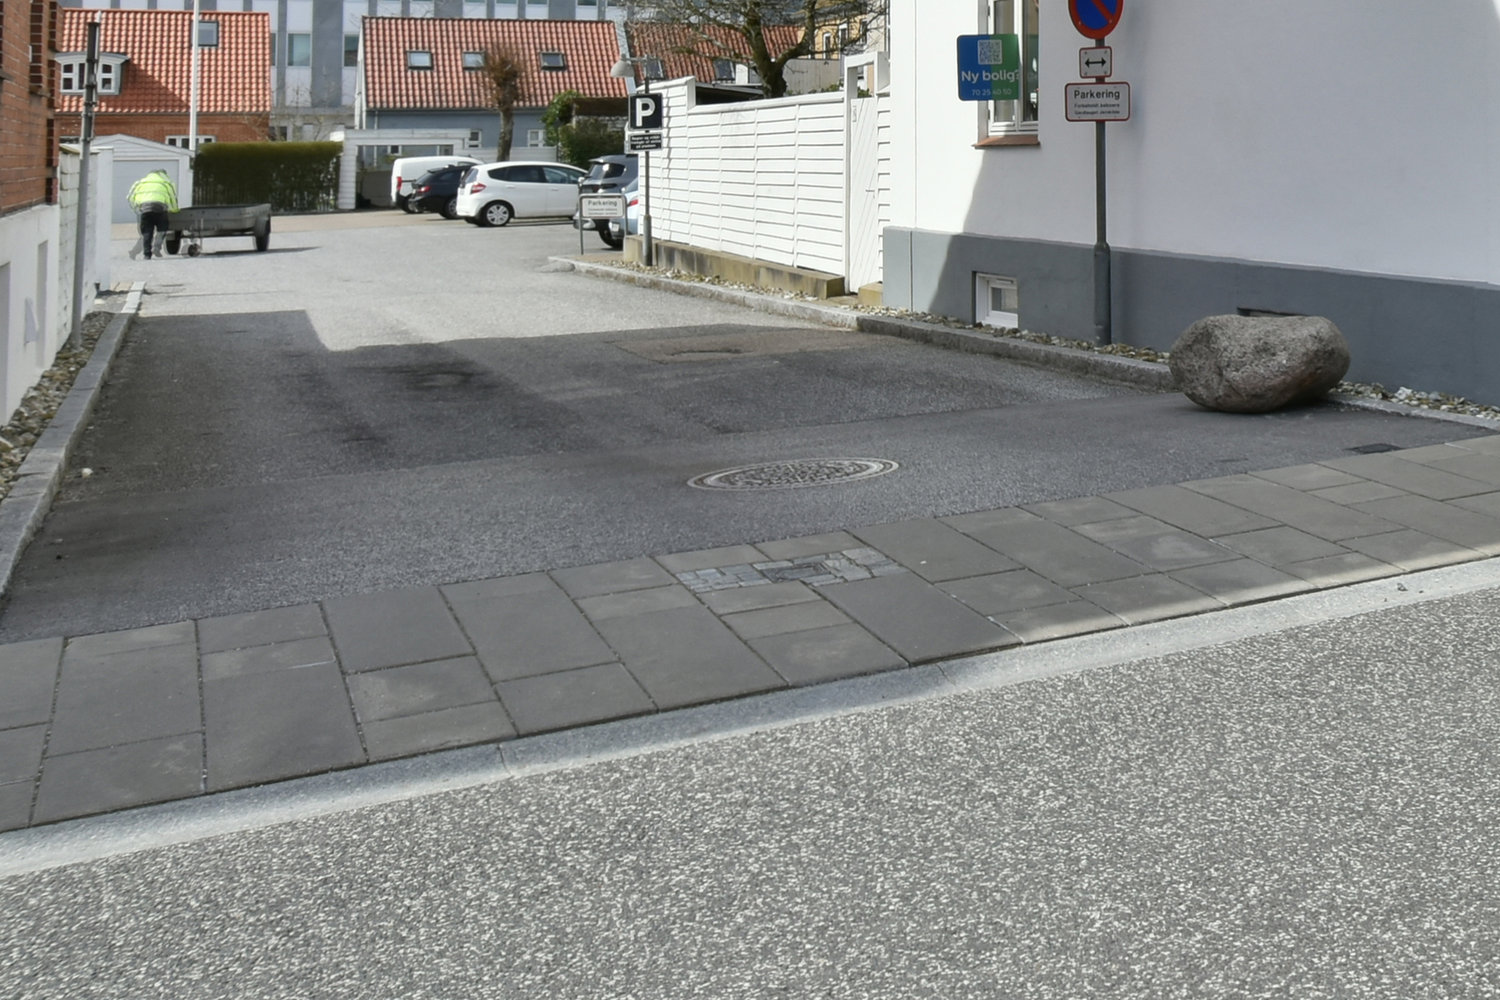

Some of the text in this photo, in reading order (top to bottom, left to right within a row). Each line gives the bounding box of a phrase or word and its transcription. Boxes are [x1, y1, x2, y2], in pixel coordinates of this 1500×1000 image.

[961, 70, 979, 84] Ny
[1074, 89, 1120, 101] Parkering
[636, 97, 656, 127] P
